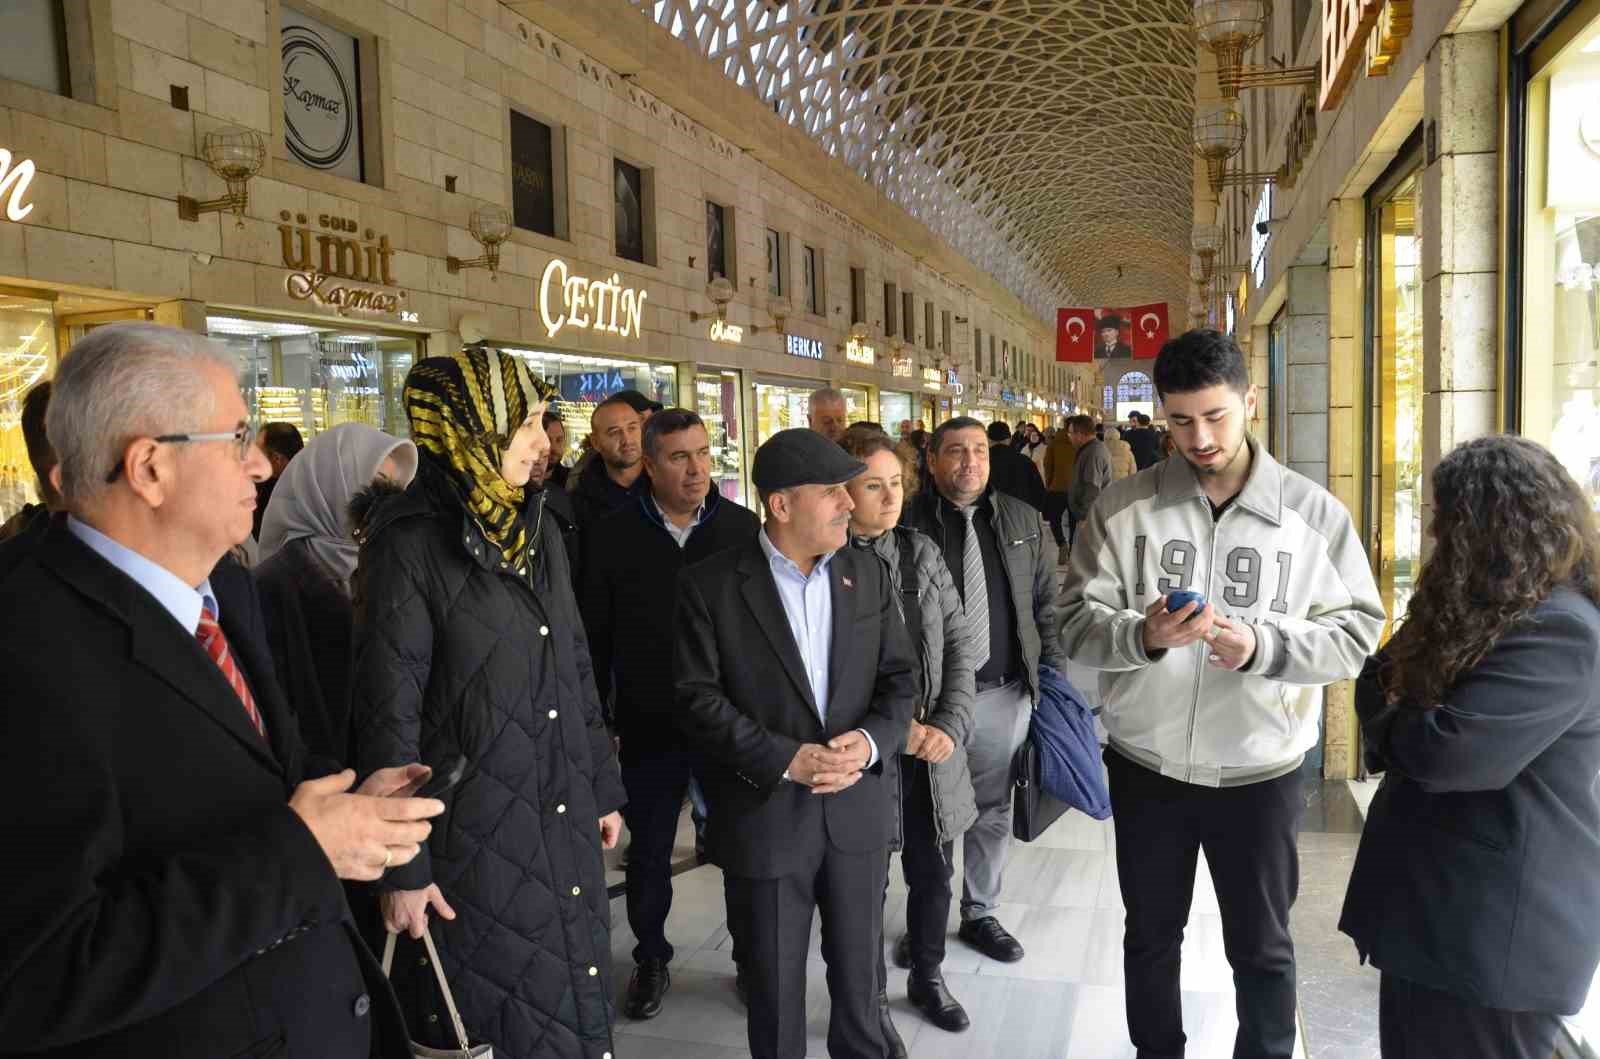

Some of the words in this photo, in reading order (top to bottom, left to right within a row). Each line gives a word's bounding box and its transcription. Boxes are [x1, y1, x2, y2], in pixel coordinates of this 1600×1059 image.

[540, 260, 647, 339] ÇETİN
[787, 335, 823, 360] BERKAS
[1134, 535, 1292, 614] 1991
